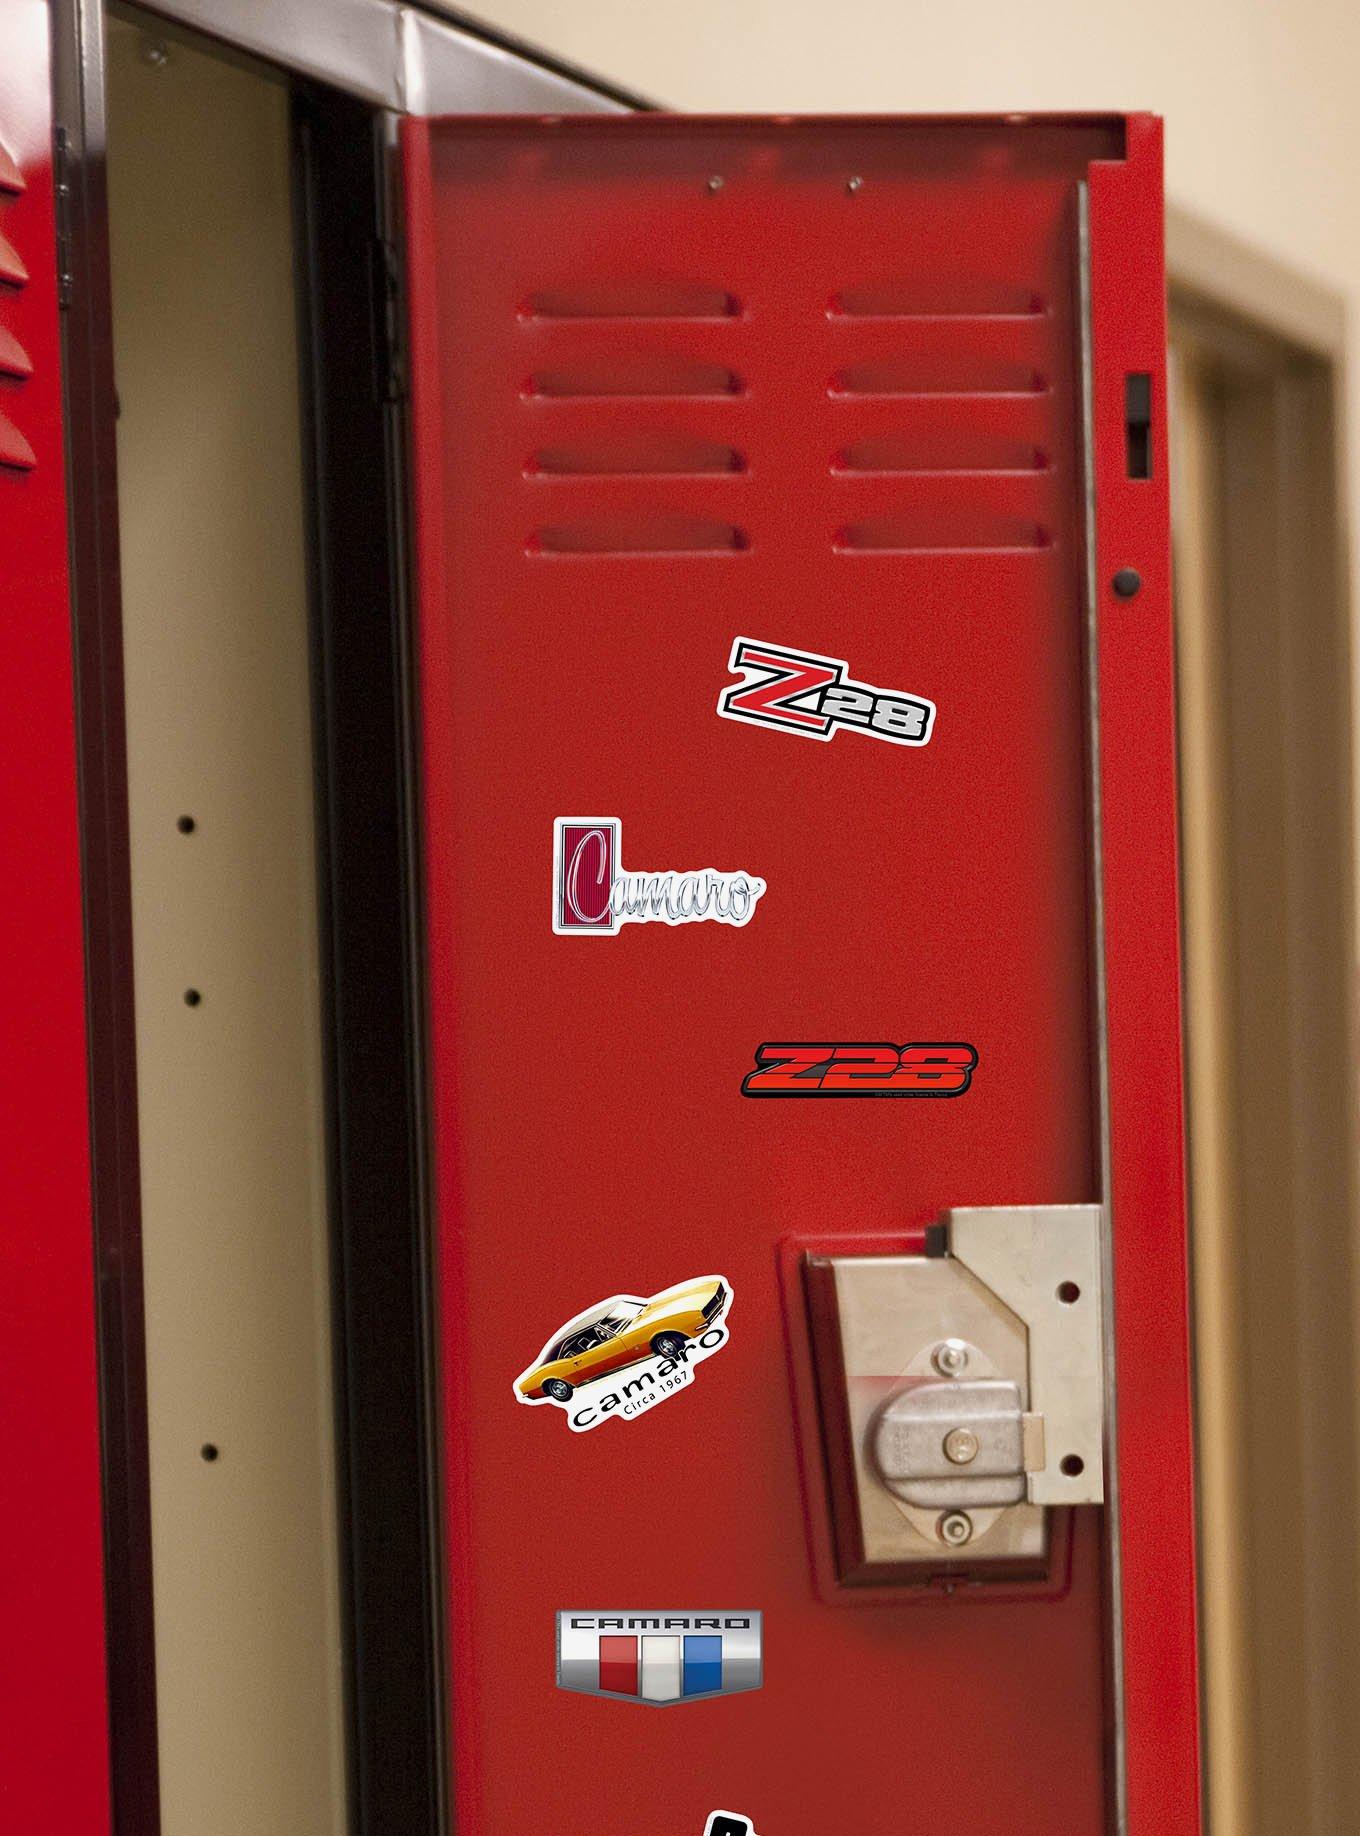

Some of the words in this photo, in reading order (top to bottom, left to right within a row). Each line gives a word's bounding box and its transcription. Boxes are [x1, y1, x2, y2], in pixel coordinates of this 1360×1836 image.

[723, 643, 930, 741] Z28
[567, 830, 760, 923] Camaro
[745, 1046, 974, 1091] Z28
[623, 1393, 656, 1415] Circa
[659, 1370, 688, 1393] 1967
[570, 1618, 750, 1629] CAMARO
